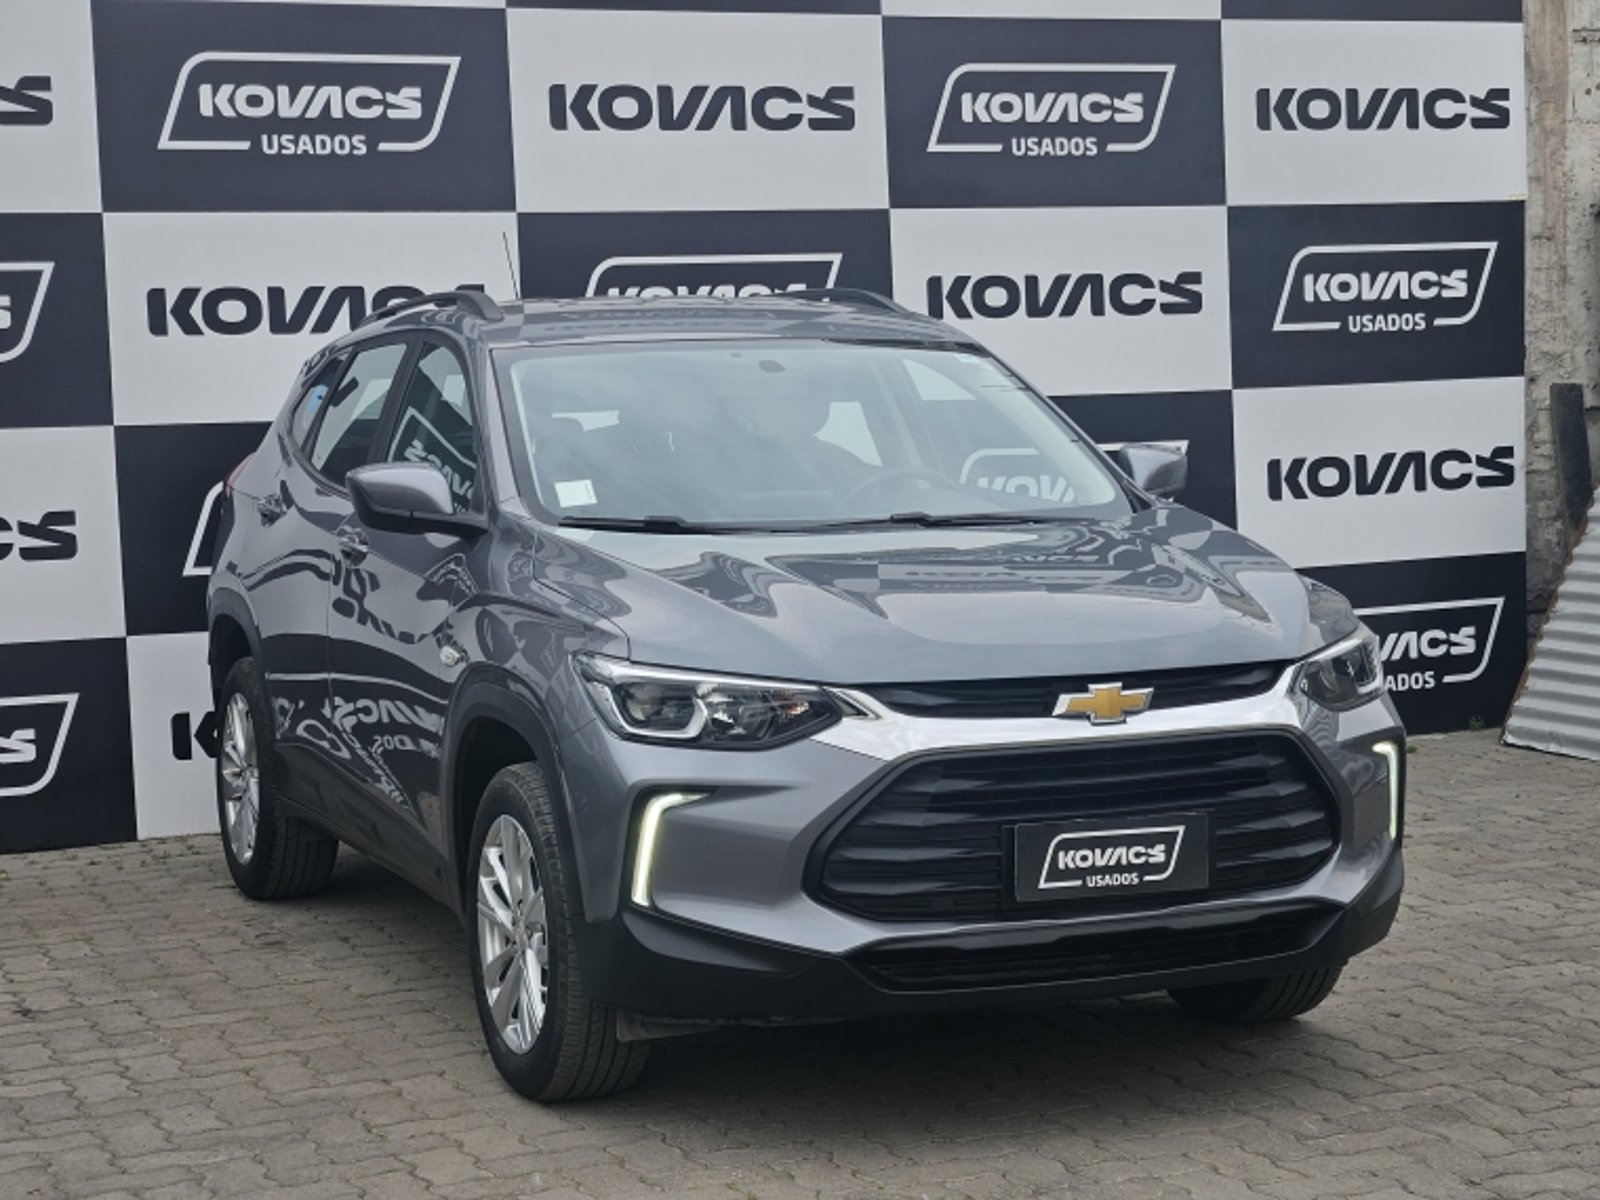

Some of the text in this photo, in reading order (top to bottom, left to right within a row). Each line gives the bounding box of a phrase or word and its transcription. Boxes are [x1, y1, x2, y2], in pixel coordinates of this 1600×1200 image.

[198, 83, 422, 120] KOVACS
[549, 83, 856, 132] KOVACS
[961, 92, 1144, 123] KOVACS
[1256, 87, 1510, 131] KOVACS
[261, 134, 367, 156] USADOS
[1011, 136, 1098, 157] USADOS
[927, 271, 1203, 319] KOVACS
[1303, 269, 1468, 303] KOVACS
[1348, 312, 1426, 333] USADOS
[1267, 445, 1516, 502] KOVACS
[1058, 844, 1166, 870] KOVACS
[1086, 872, 1140, 888] USADOS
